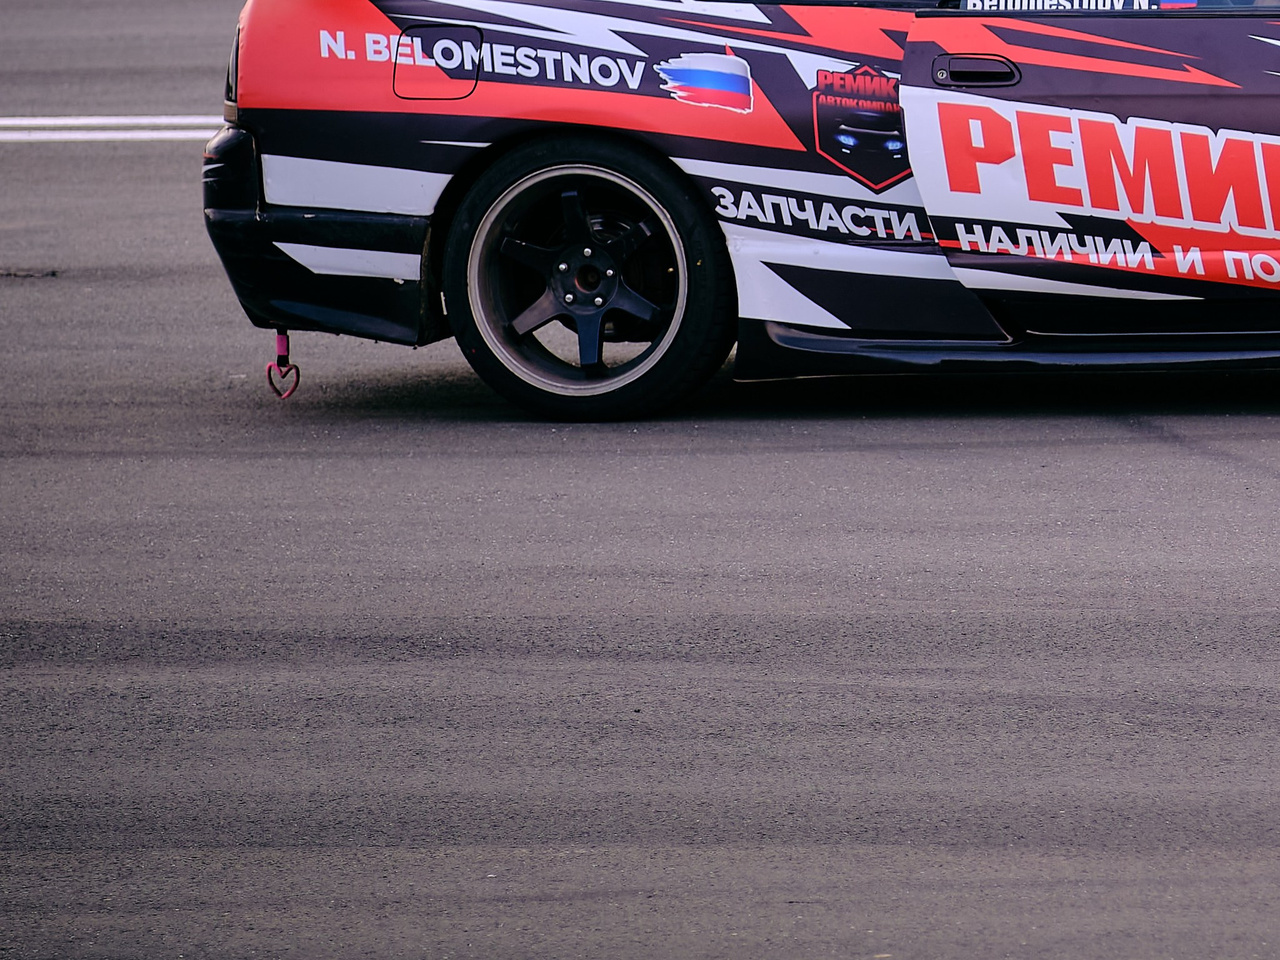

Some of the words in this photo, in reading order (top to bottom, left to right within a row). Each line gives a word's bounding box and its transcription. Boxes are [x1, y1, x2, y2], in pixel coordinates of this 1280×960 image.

[320, 29, 355, 60] N.
[366, 32, 646, 90] BELOMESTNOV
[714, 186, 922, 242] ЗАПЧАСТИ
[955, 223, 1155, 271] НАЛИЧИИ
[1173, 245, 1206, 277] И
